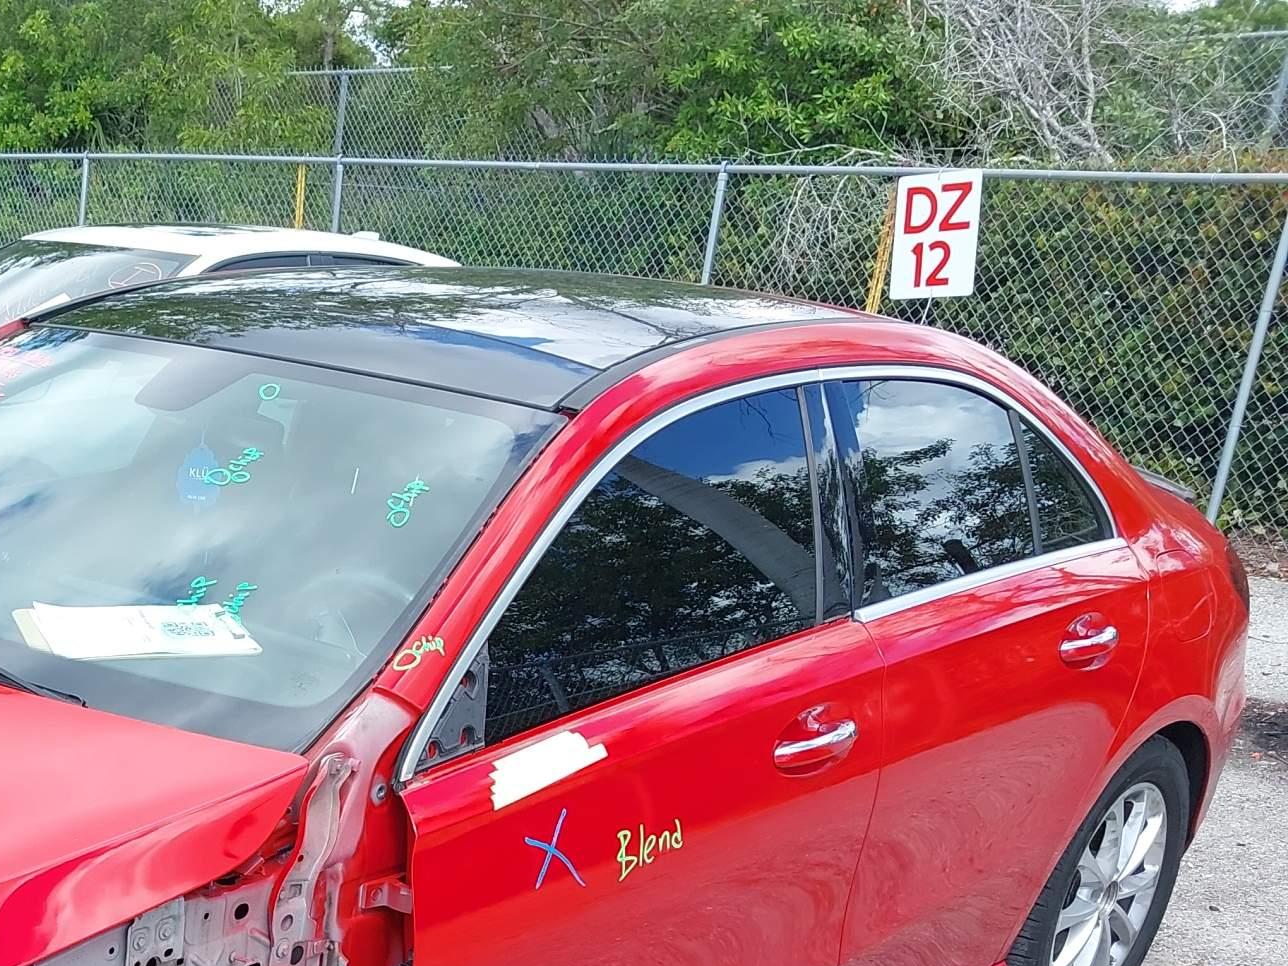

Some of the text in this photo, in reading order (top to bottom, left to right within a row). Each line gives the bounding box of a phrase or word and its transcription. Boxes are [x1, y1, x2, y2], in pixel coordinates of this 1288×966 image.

[903, 181, 973, 234] DZ
[910, 240, 951, 288] 12
[616, 818, 684, 883] Blend
